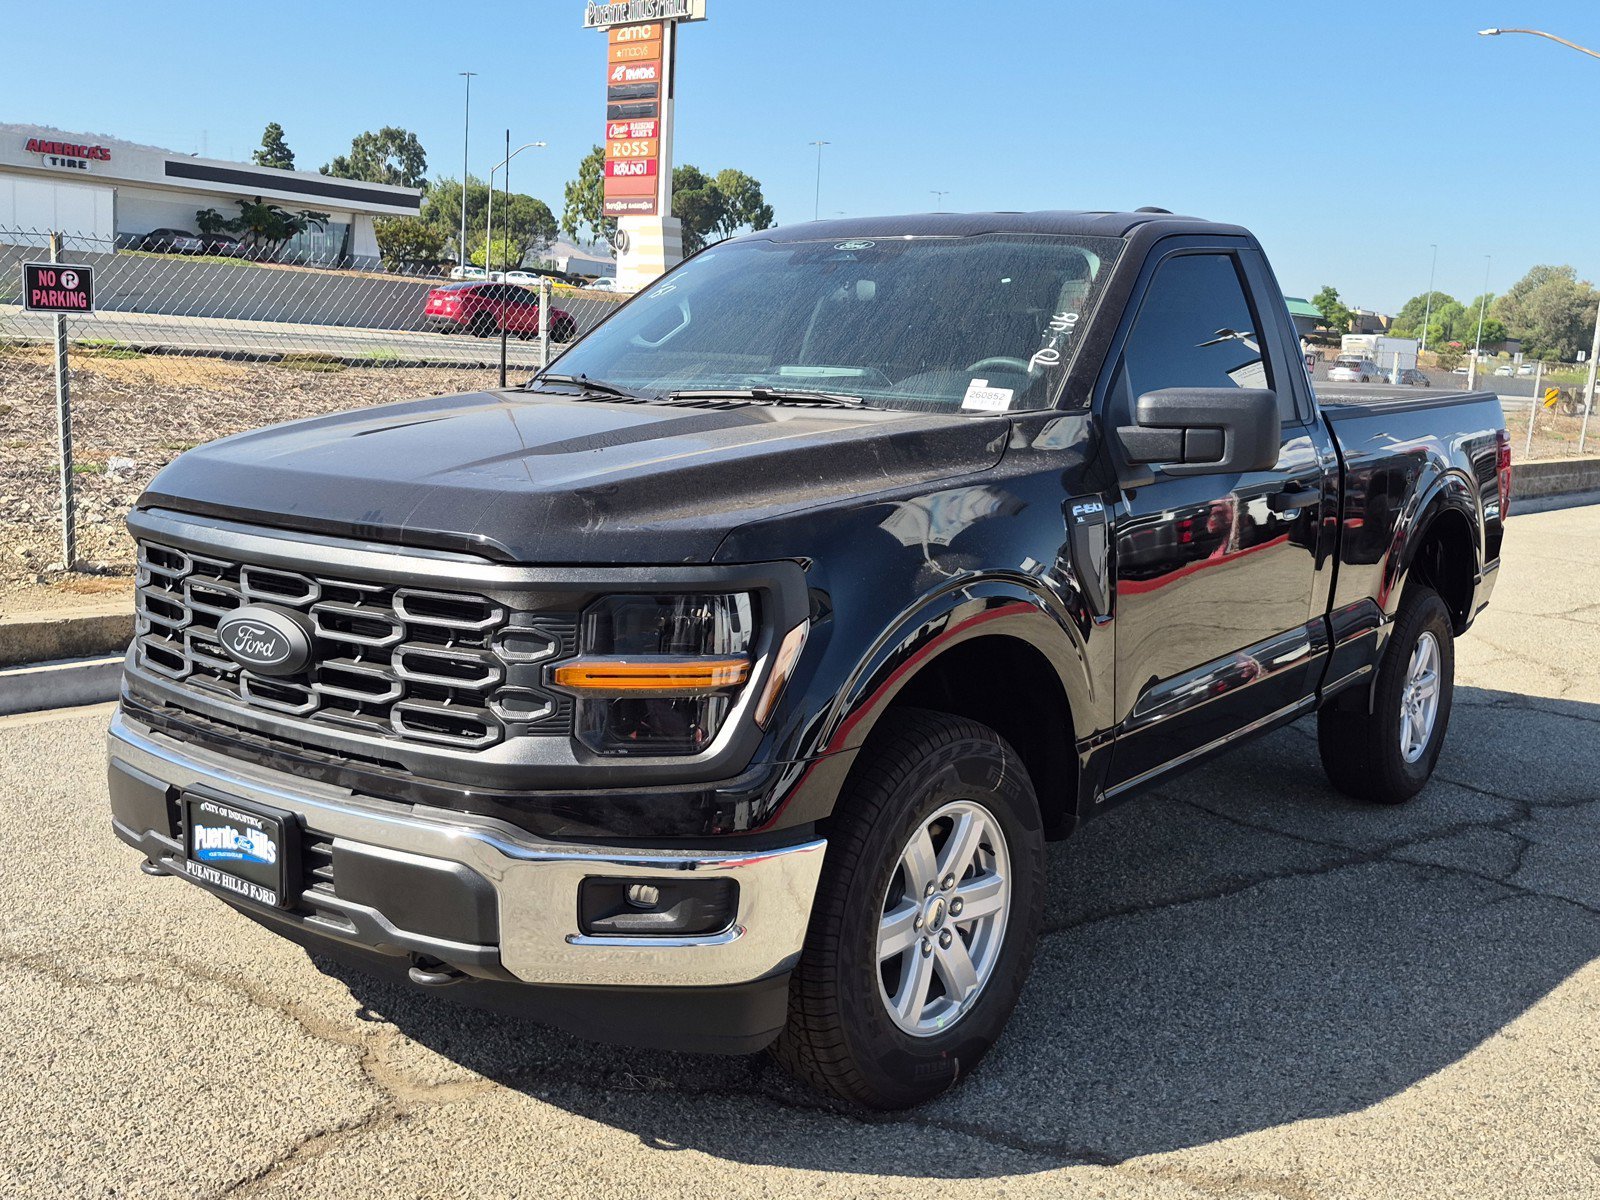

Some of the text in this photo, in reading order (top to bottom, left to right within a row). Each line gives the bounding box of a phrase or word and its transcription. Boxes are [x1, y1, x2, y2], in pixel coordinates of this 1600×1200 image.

[588, 0, 629, 25] PUENTE
[25, 138, 111, 160] AMERICA'S
[613, 141, 649, 157] ROSS
[50, 156, 87, 169] TIRE
[38, 270, 56, 287] NO
[32, 289, 87, 308] PARKING
[969, 390, 1006, 401] 260852
[234, 625, 276, 657] Ford
[204, 802, 259, 826] CITY OF INDUSTRY
[194, 824, 240, 850] Puente
[186, 861, 276, 906] PUENTE HILLS FORD
